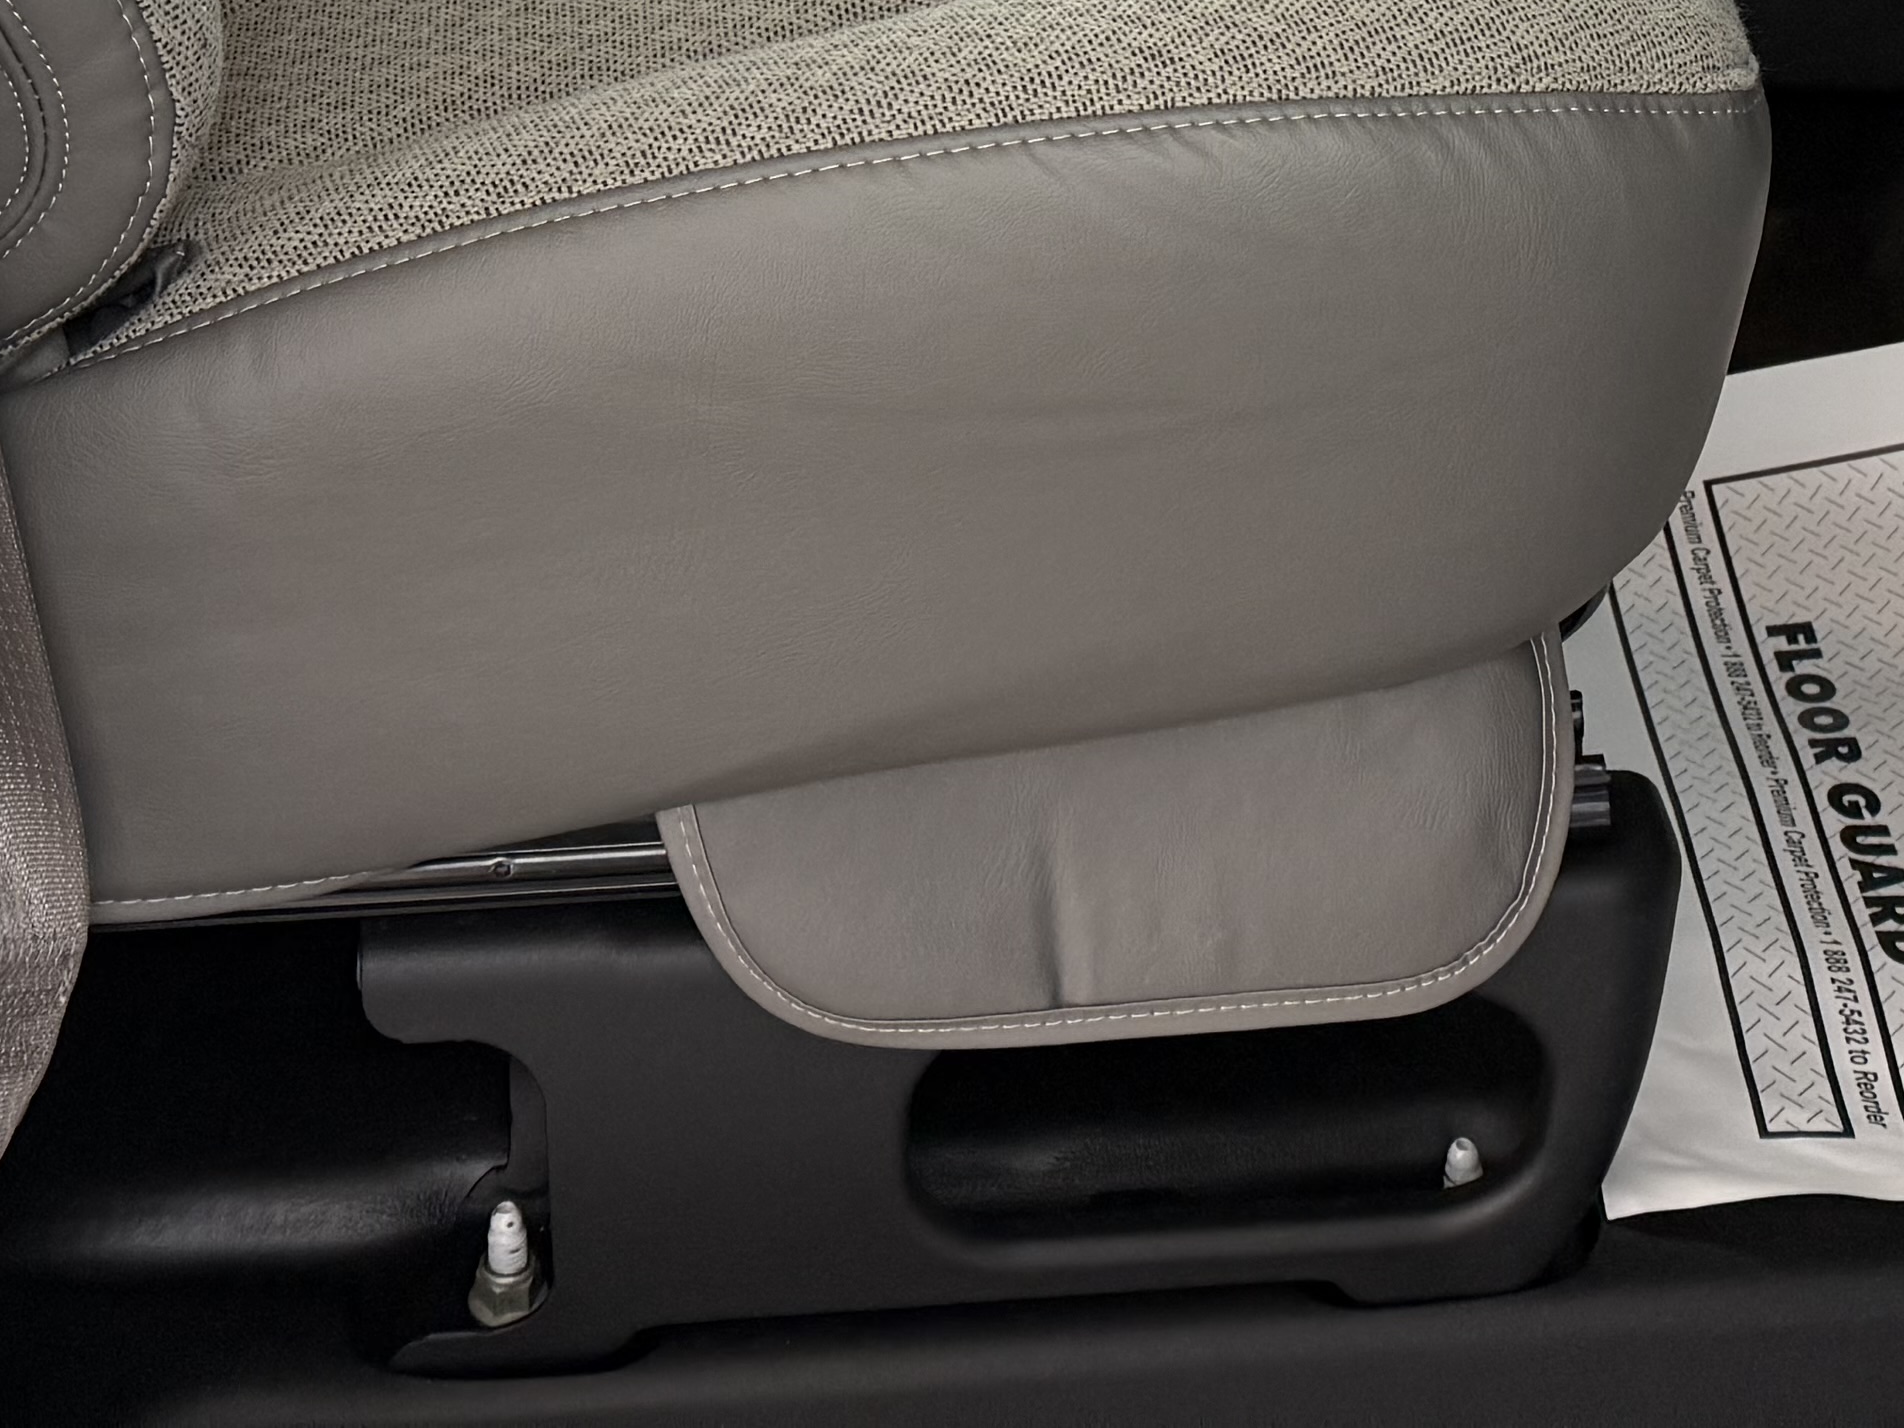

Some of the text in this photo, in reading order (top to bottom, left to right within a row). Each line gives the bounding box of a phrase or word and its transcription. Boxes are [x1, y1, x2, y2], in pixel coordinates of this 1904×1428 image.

[1690, 547, 1716, 585] Carpet
[1703, 587, 1733, 644] Protection
[1723, 660, 1748, 678] 888
[1765, 621, 1863, 764] FLOOR
[1752, 732, 1780, 771] Reorder
[1766, 777, 1797, 827] Premium
[1783, 830, 1814, 871] Carpet
[1796, 869, 1832, 929] Protection
[1820, 939, 1843, 947] 1
[1823, 948, 1851, 974] 888
[1830, 976, 1870, 1045] 247-5432
[1849, 1048, 1871, 1065] to
[1853, 1069, 1889, 1129] Reorder
